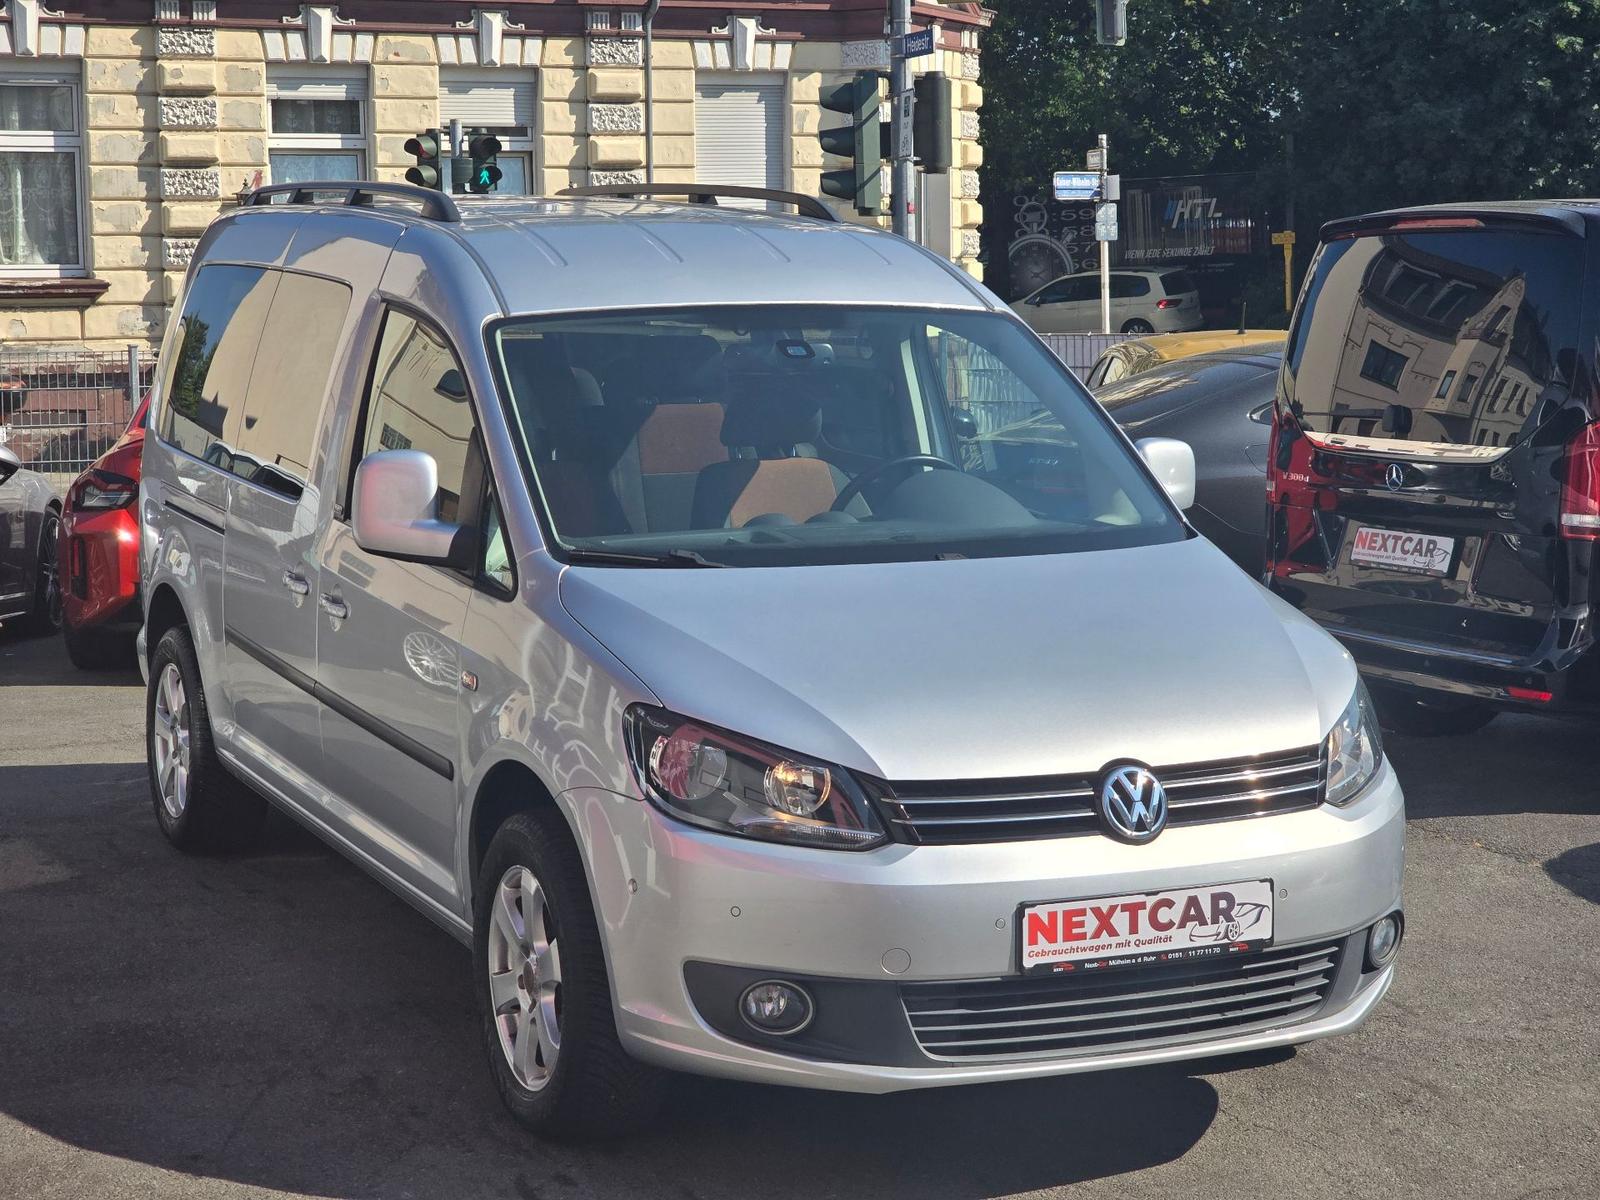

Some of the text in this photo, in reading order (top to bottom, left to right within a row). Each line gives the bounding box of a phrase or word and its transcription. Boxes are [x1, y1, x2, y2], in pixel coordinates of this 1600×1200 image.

[906, 36, 932, 54] Heidestr.
[1355, 531, 1438, 559] NEXTCAR
[1027, 891, 1236, 946] NEXTCAR
[1027, 935, 1173, 958] Gebrauchtwagen mit Qualität
[1143, 955, 1157, 963] Ruhr
[1168, 952, 1183, 960] 0151
